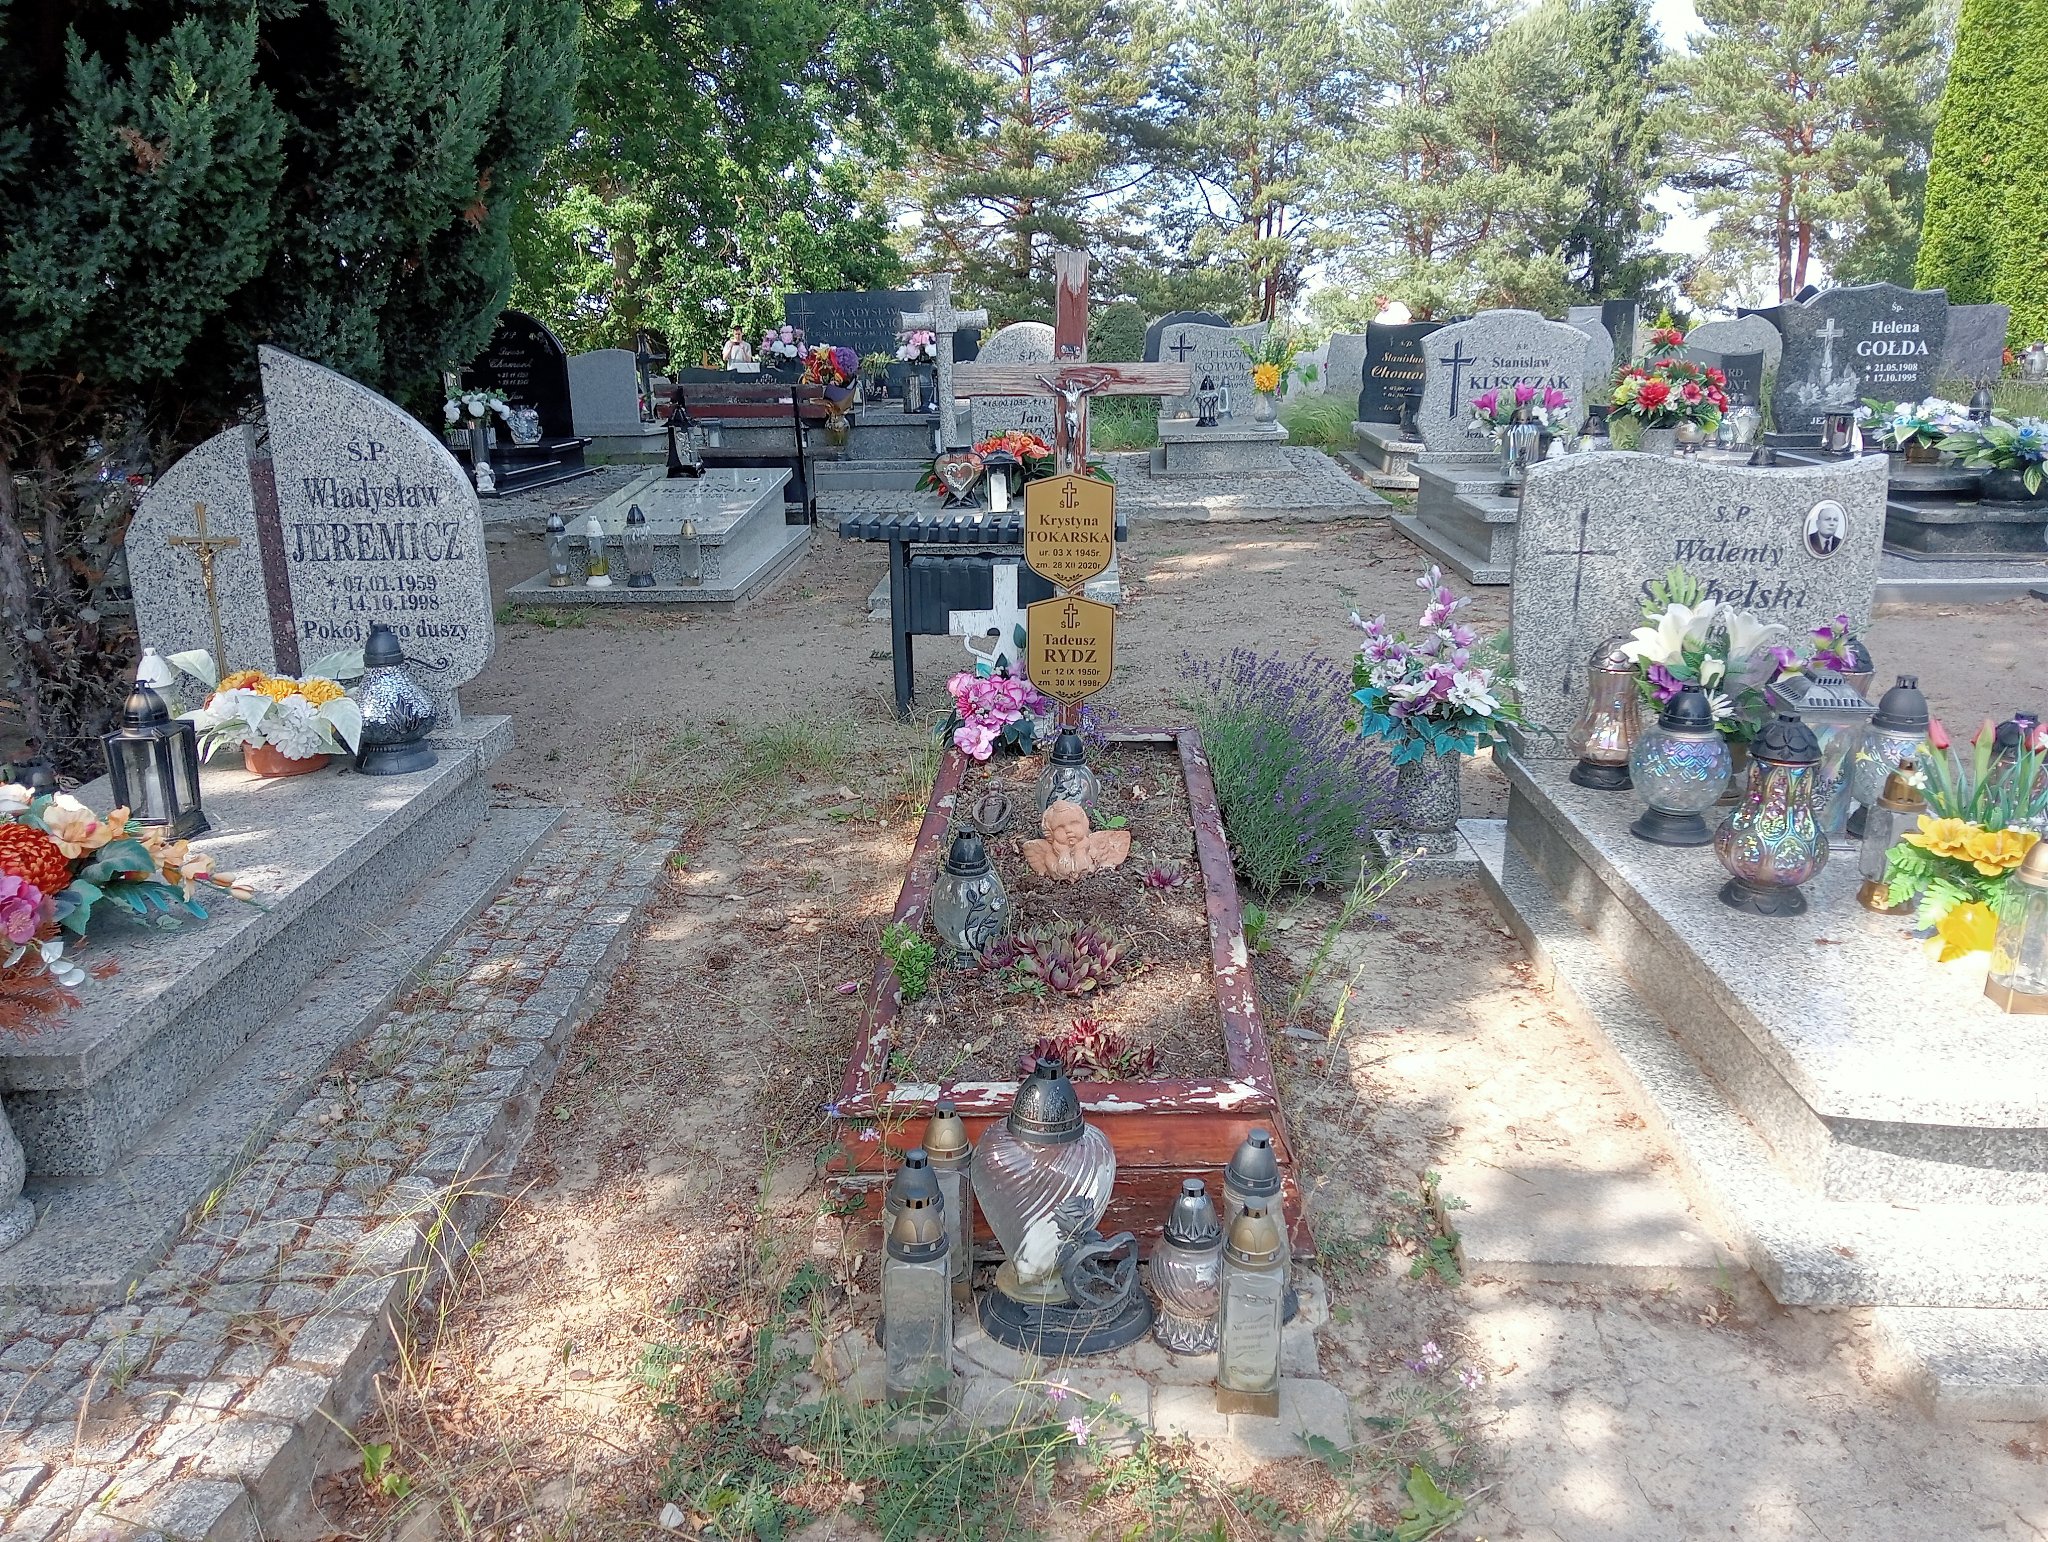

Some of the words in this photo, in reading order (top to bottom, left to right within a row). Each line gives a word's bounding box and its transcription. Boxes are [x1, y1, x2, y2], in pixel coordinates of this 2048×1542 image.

[823, 319, 898, 330] SIENKIEWIC
[1870, 320, 1920, 334] Helena
[1856, 339, 1930, 357] GOŁDA
[1194, 361, 1251, 372] KOTWIC
[1873, 363, 1918, 373] 21.05.1908
[1469, 375, 1570, 390] KLISZCZAK
[1873, 373, 1917, 383] 17.10.1995
[1020, 411, 1042, 425] Jan
[1810, 416, 1825, 425] JEZ
[303, 477, 440, 515] Władysław
[1039, 514, 1099, 529] Krystyna
[292, 522, 464, 562] JEREMICZ
[1027, 532, 1110, 543] TOKARSKA
[1053, 549, 1064, 557] 03
[1066, 549, 1073, 557] X
[1075, 549, 1102, 558] 1945r.
[1673, 539, 1784, 571] Walenty
[1052, 561, 1063, 569] 28
[1065, 561, 1076, 569] XII
[343, 576, 437, 592] 07.01.1959
[348, 594, 441, 611] 14.10.1998
[303, 620, 362, 642] Pokój
[416, 619, 470, 642] duszy
[1043, 633, 1096, 646] Tadeusz
[1044, 649, 1097, 663] RYDZ
[1055, 668, 1065, 676] 12
[1066, 668, 1075, 676] IX
[1055, 679, 1065, 687] 30
[1067, 679, 1075, 687] IX
